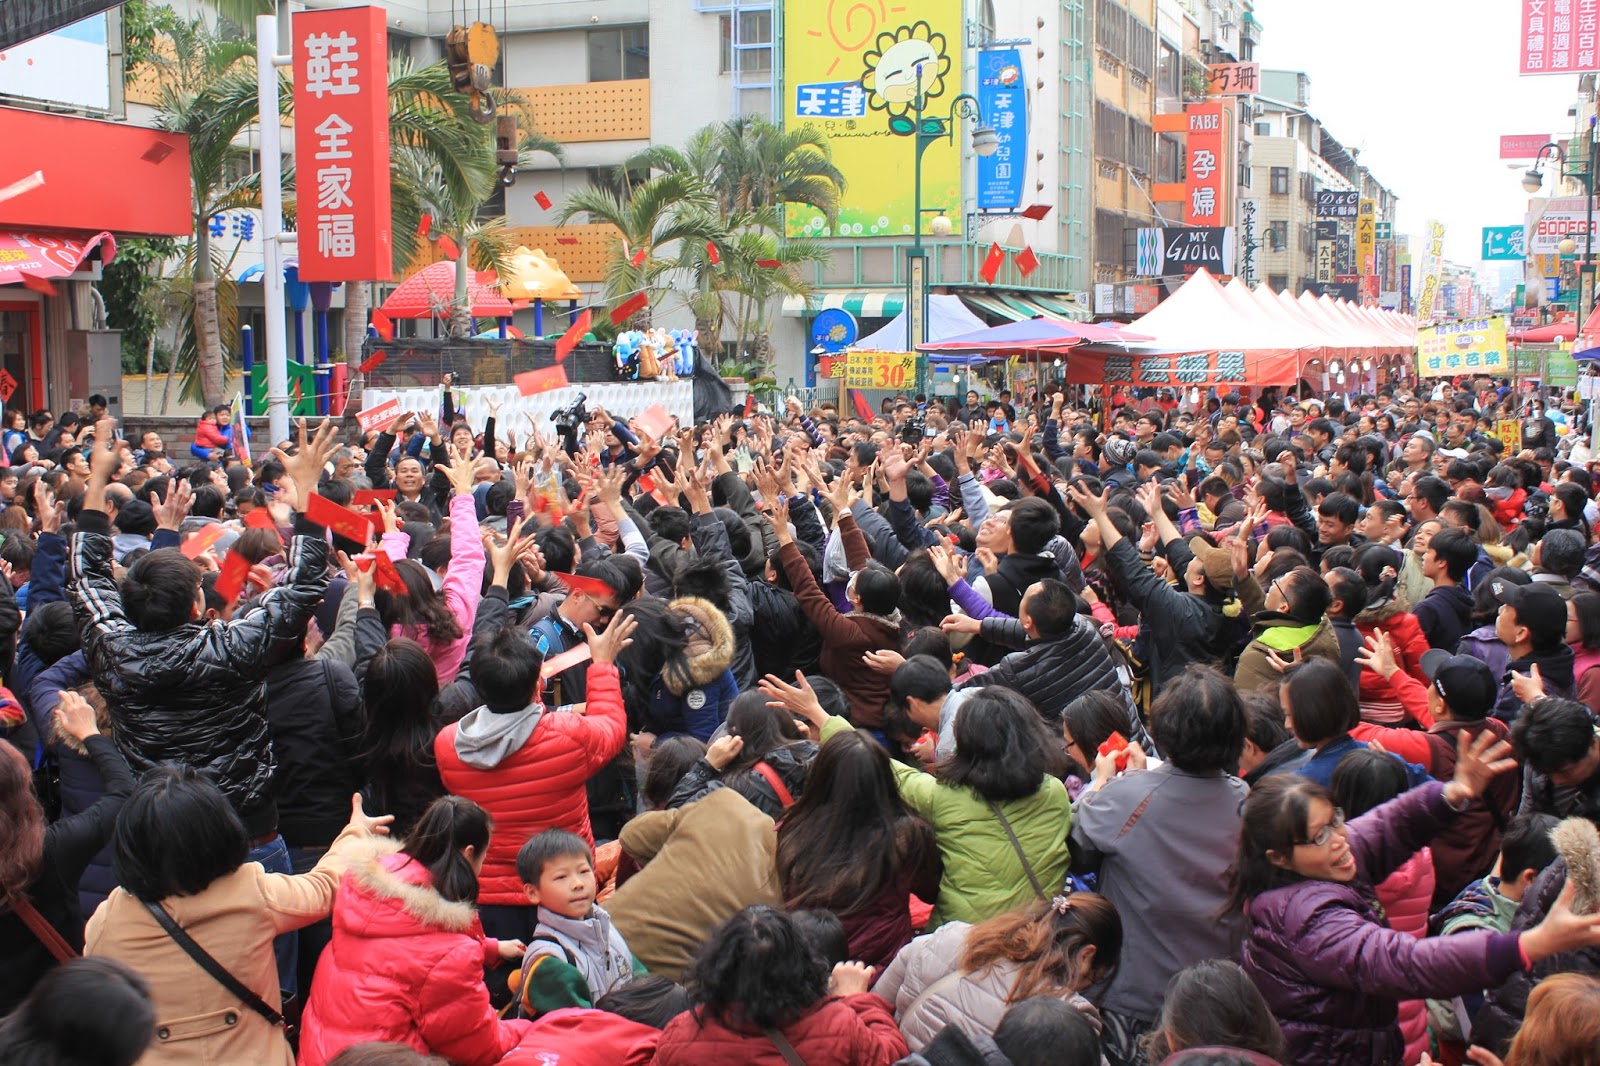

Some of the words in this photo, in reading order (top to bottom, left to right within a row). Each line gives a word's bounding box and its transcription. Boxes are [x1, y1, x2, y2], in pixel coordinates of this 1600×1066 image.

[1526, 0, 1546, 69] 文具禮品
[1551, 0, 1571, 69] 電腦週邊
[1577, 0, 1597, 68] 生活百貨
[799, 85, 865, 117] 天津
[1189, 114, 1219, 130] FABE
[304, 31, 360, 259] 鞋全家福
[992, 93, 1015, 179] 天津幼兒園
[1192, 149, 1216, 228] 孕婦
[1319, 193, 1334, 205] D
[1335, 195, 1345, 204] &
[1347, 192, 1358, 205] C
[1319, 205, 1357, 216] 大千服飾
[208, 214, 255, 241] 天津
[1189, 231, 1209, 242] MY
[1538, 220, 1597, 236] BODEGA
[1485, 229, 1525, 257] 仁愛
[1320, 245, 1330, 283] 大千服
[1427, 350, 1501, 370] 甘草芭樂
[875, 364, 905, 388] 30
[904, 378, 913, 389] 元
